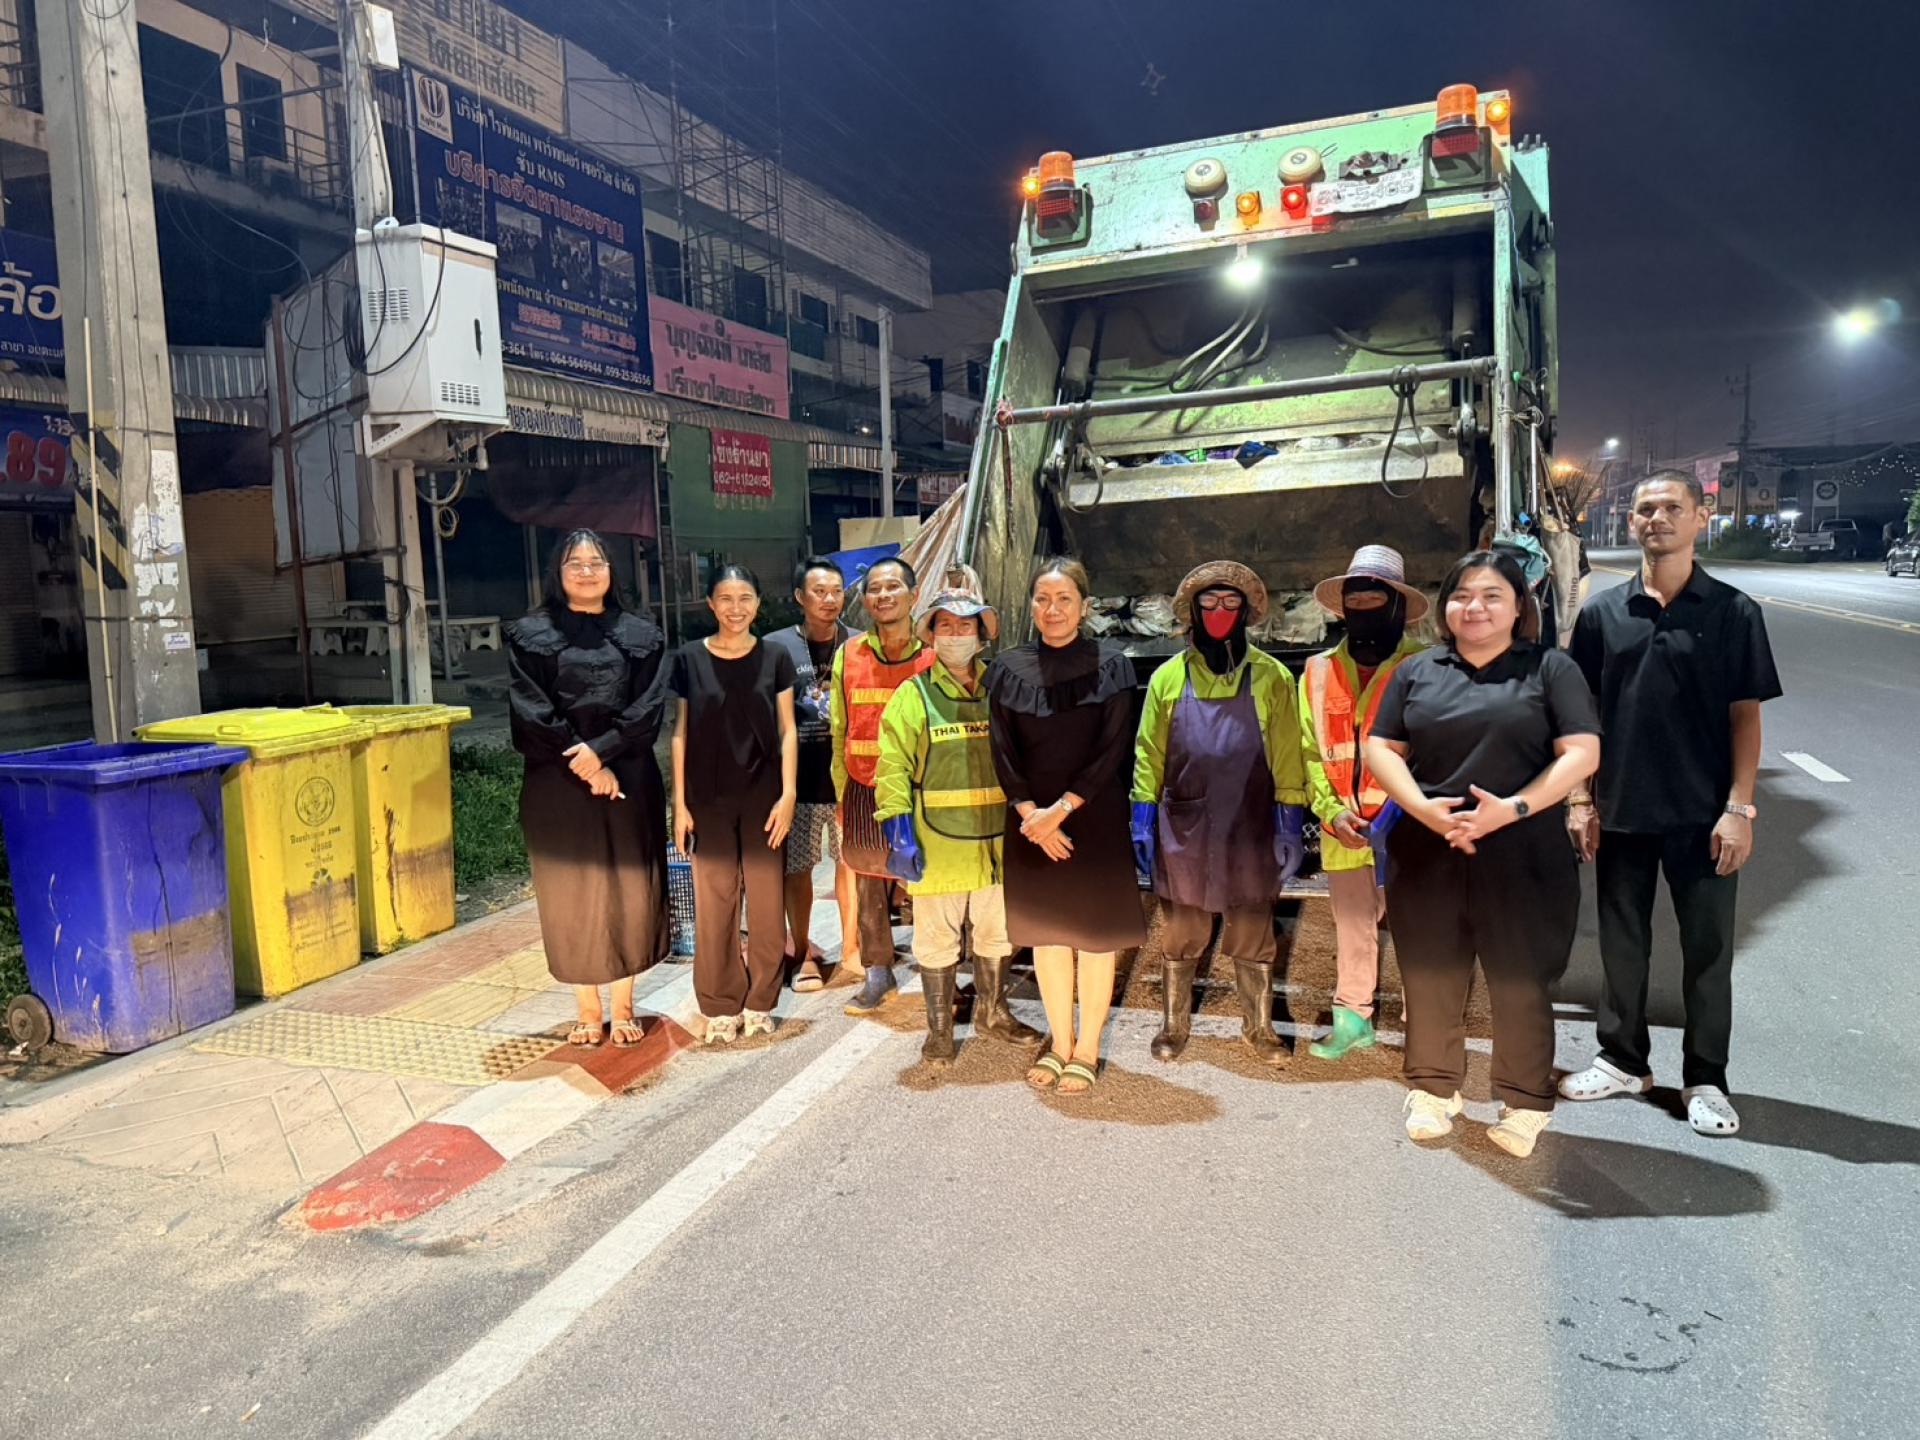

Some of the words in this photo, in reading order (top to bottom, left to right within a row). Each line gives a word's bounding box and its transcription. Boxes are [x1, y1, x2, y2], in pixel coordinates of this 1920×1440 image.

[454, 96, 488, 127] บริษัท
[537, 163, 566, 189] RMS
[444, 148, 625, 245] บริการจัดหาแรงงาน
[933, 725, 960, 737] THAI
